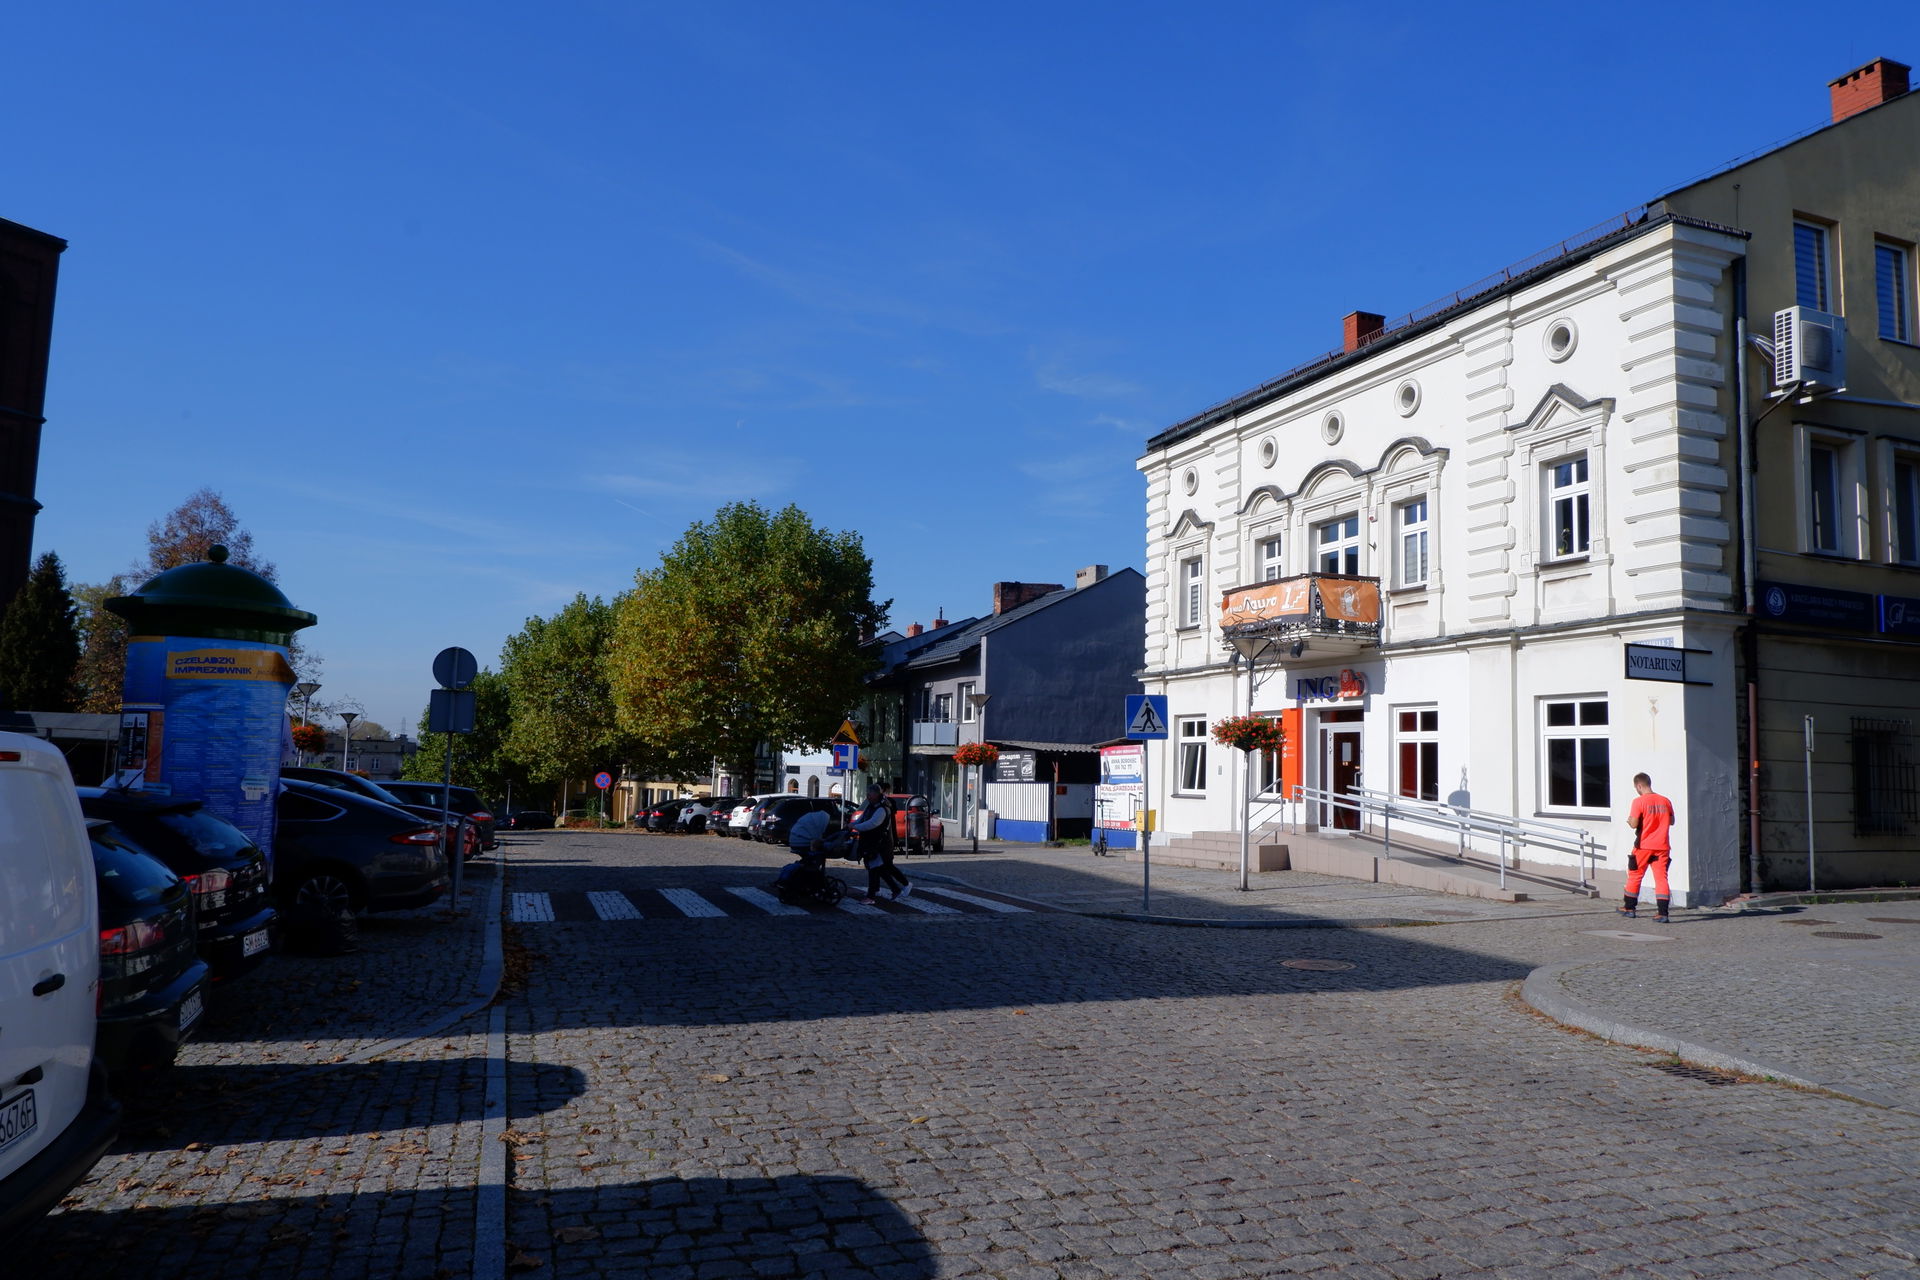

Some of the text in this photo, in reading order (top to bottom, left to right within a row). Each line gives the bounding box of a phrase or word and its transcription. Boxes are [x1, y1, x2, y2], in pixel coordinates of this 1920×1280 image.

[175, 656, 235, 665] CZELADZKI
[1630, 655, 1682, 672] NOTARIUSZ
[174, 666, 252, 675] IMPREZOWNIK
[1296, 676, 1335, 700] ING
